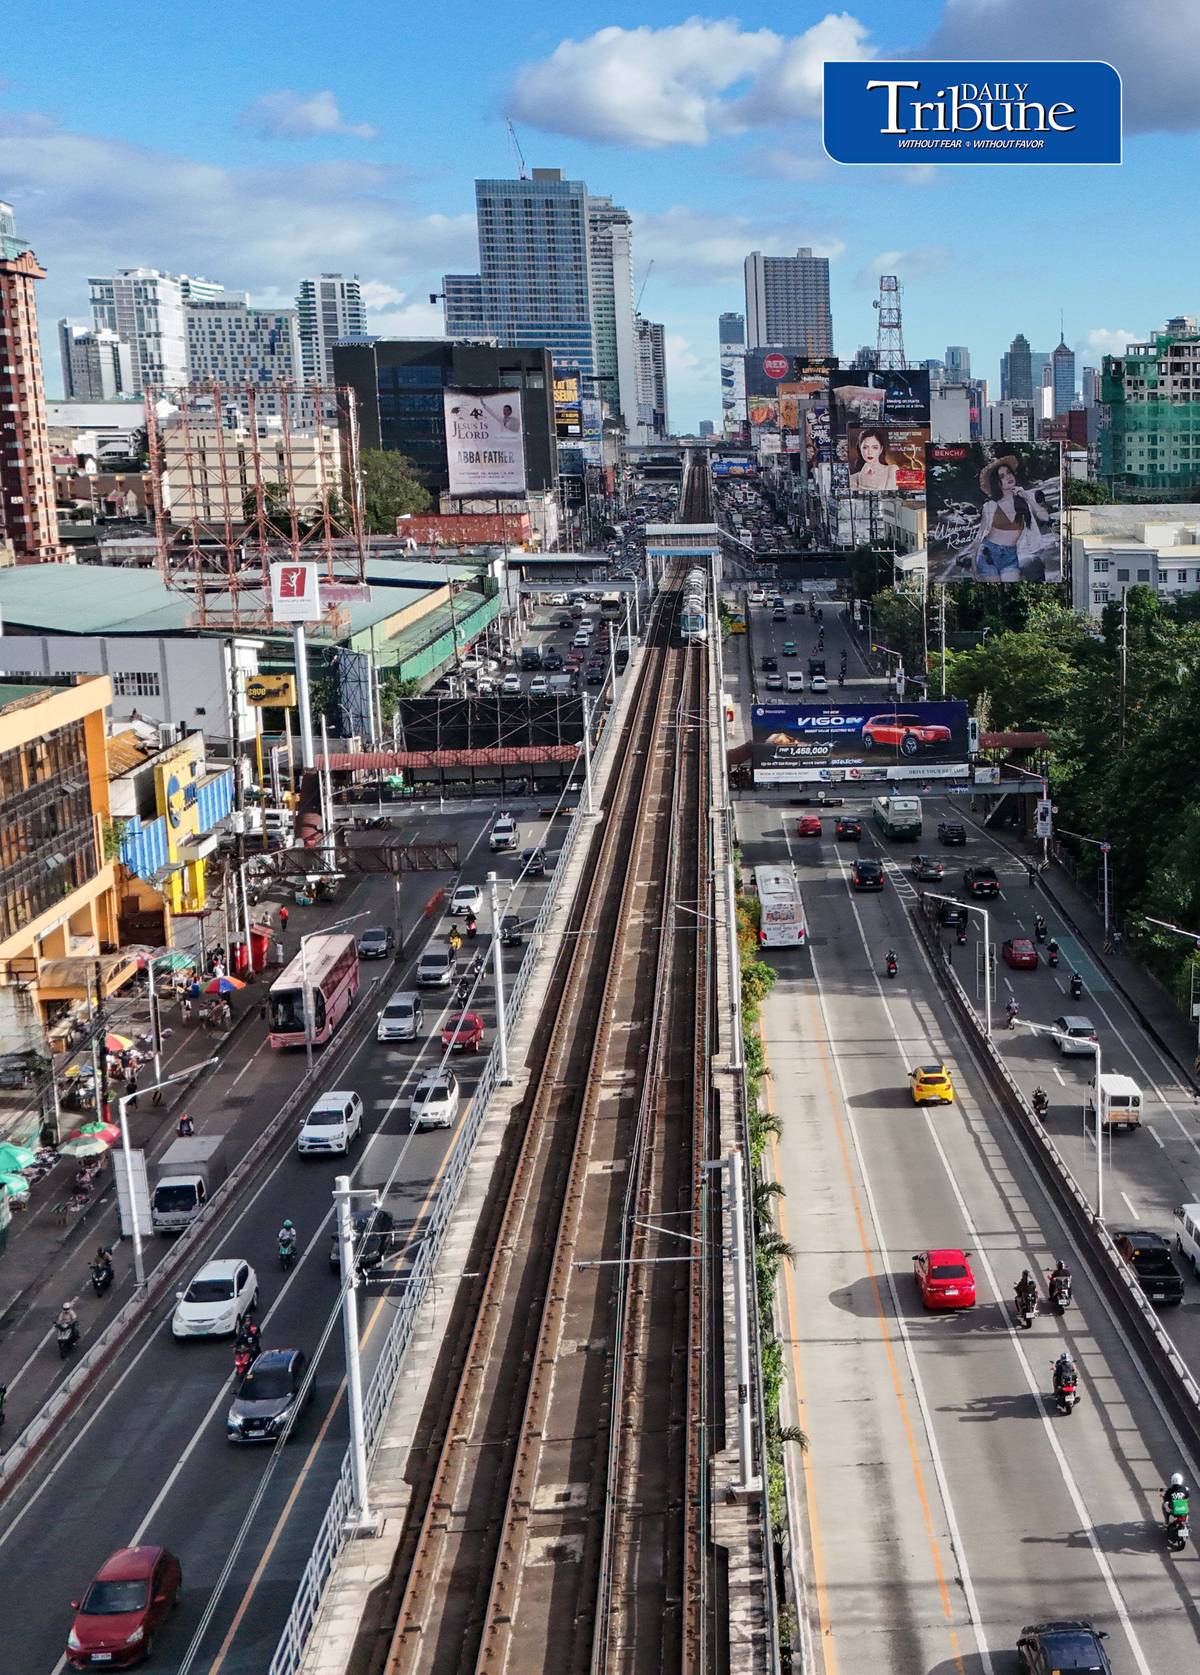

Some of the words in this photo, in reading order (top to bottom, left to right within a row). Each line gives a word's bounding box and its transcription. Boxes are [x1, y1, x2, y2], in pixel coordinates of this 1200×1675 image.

[458, 430, 490, 440] LORD
[458, 451, 480, 464] ABBA
[484, 451, 515, 464] FATHER
[798, 717, 845, 726] VIGO
